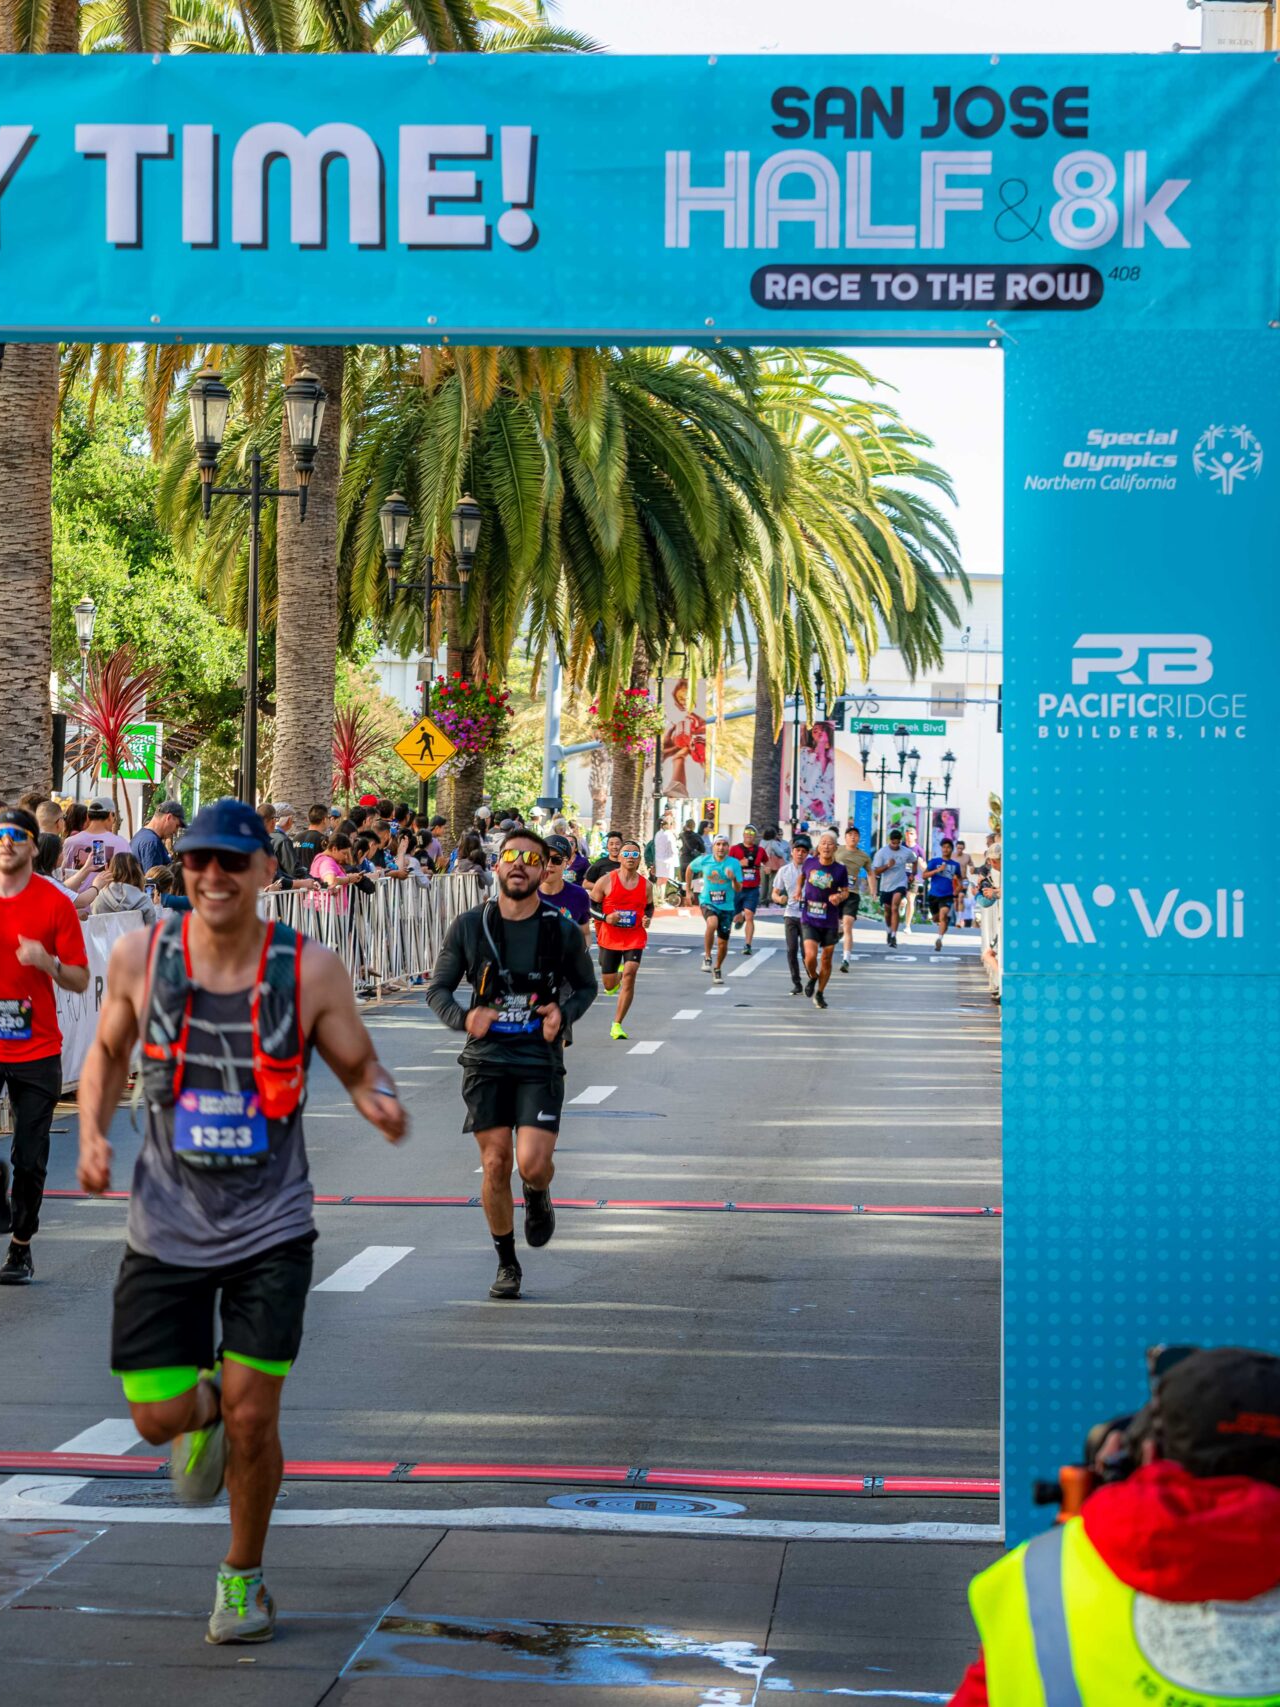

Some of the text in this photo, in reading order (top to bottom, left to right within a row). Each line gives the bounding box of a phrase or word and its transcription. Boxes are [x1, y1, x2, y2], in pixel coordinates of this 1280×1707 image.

[770, 85, 1089, 140] SAN JOSE
[75, 121, 540, 251] TIME!
[664, 148, 1192, 250] HALF & 8k
[1108, 265, 1141, 283] 408
[764, 273, 1091, 301] RACE TO THE ROW
[1086, 428, 1179, 447] Special
[1063, 450, 1179, 471] Olympics
[1024, 474, 1177, 492] Northern California
[853, 721, 890, 732] Stvens
[922, 722, 944, 733] Blvd
[1038, 725, 1246, 741] BUILDERS, INC
[1128, 887, 1245, 938] Voli
[190, 1125, 253, 1149] 1323
